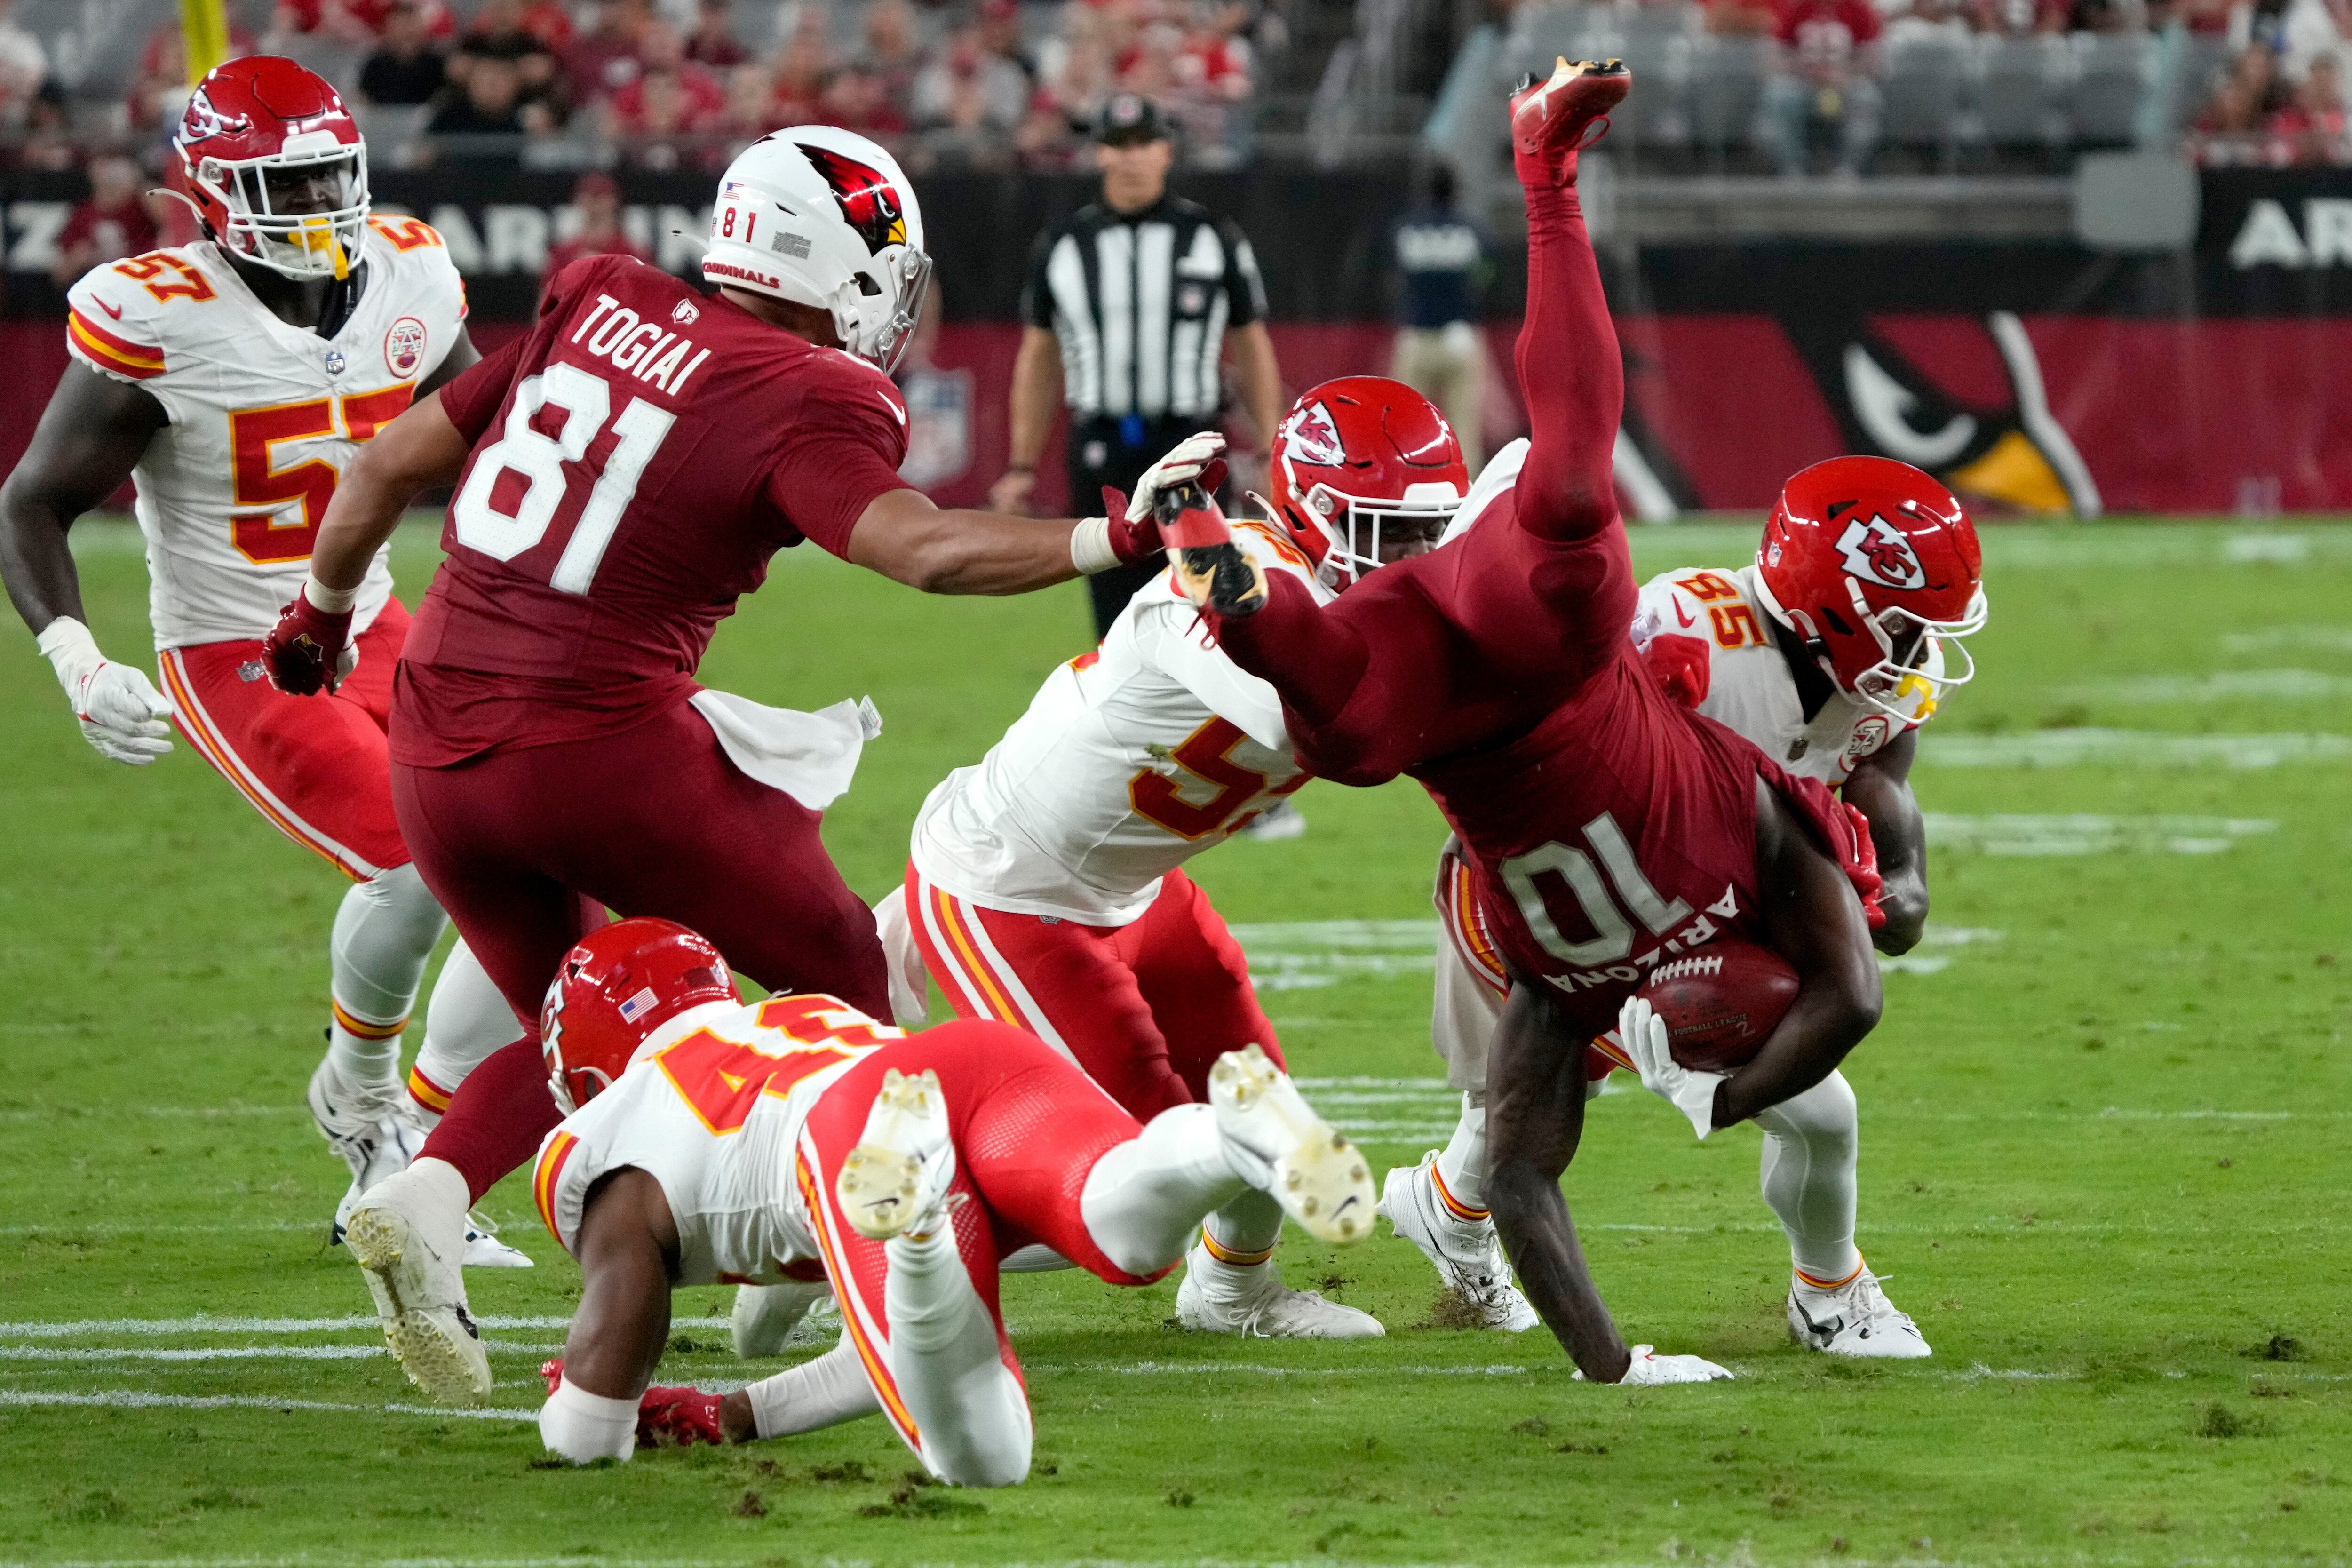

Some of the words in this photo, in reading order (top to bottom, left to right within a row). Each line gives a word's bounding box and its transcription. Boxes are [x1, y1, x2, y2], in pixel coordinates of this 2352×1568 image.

[368, 213, 444, 253] 5
[723, 207, 756, 243] 81
[113, 252, 218, 305] 57
[702, 261, 780, 289] CARDINALS
[571, 293, 711, 396] TOGIAI
[453, 360, 677, 596] 81
[1856, 527, 1917, 586] KC
[1671, 571, 1768, 651] 85
[1499, 810, 1694, 968] 10
[1542, 882, 1740, 994] ARIZONA
